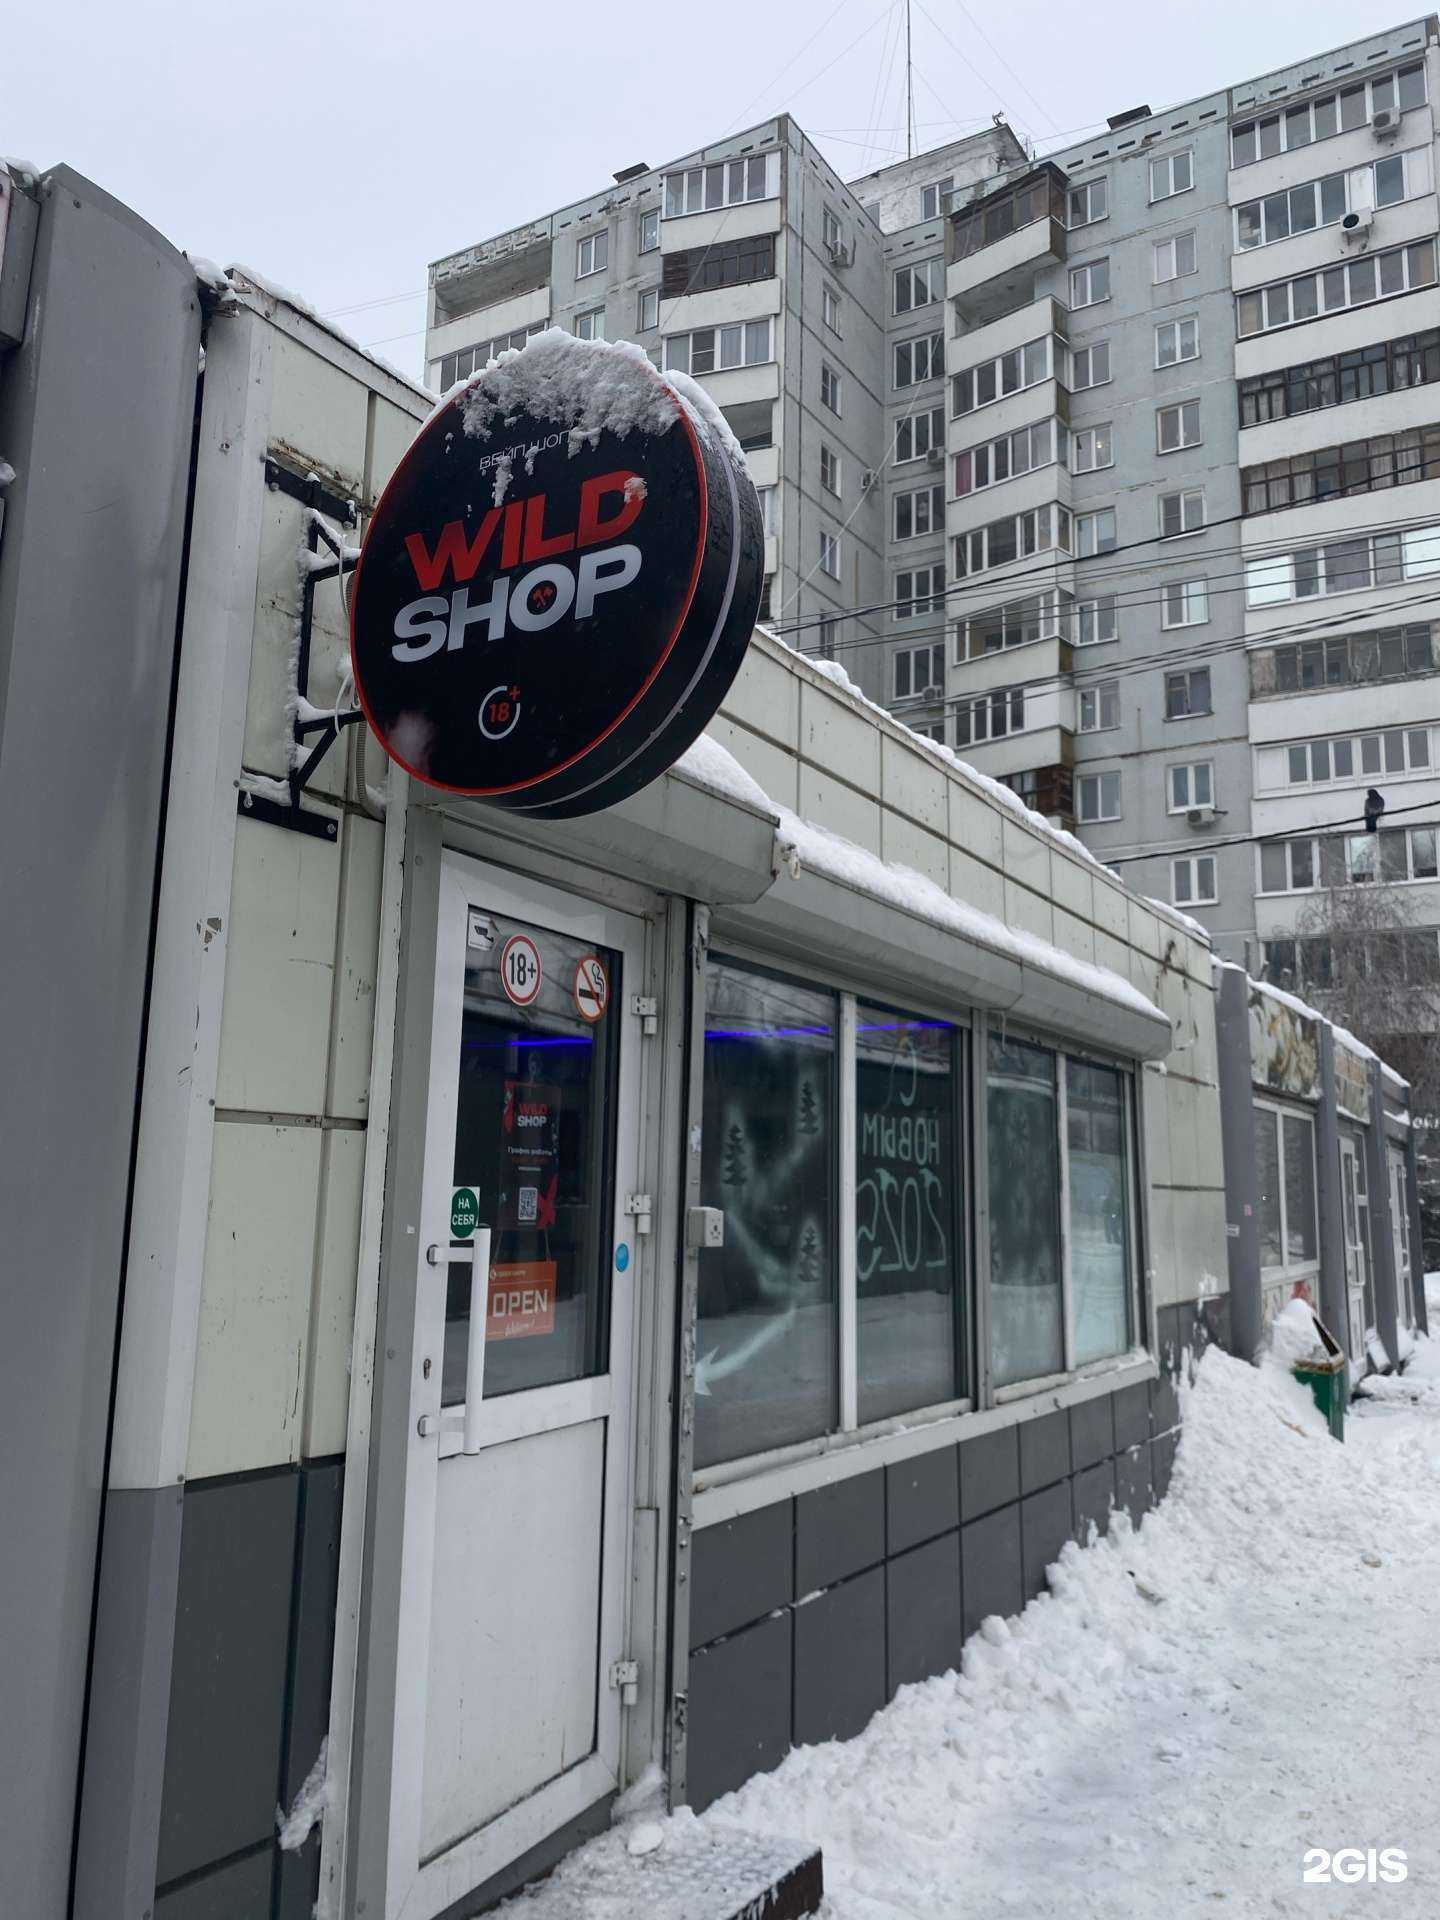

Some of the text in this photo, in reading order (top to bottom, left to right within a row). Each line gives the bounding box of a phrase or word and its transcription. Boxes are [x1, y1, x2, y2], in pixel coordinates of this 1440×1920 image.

[404, 470, 647, 592] WILD
[391, 544, 643, 663] SHOP
[508, 951, 537, 986] 18+
[517, 1114, 547, 1128] SHOP
[457, 1197, 471, 1210] НА
[451, 1213, 475, 1226] СЕБЯ
[492, 1288, 549, 1318] OPEN
